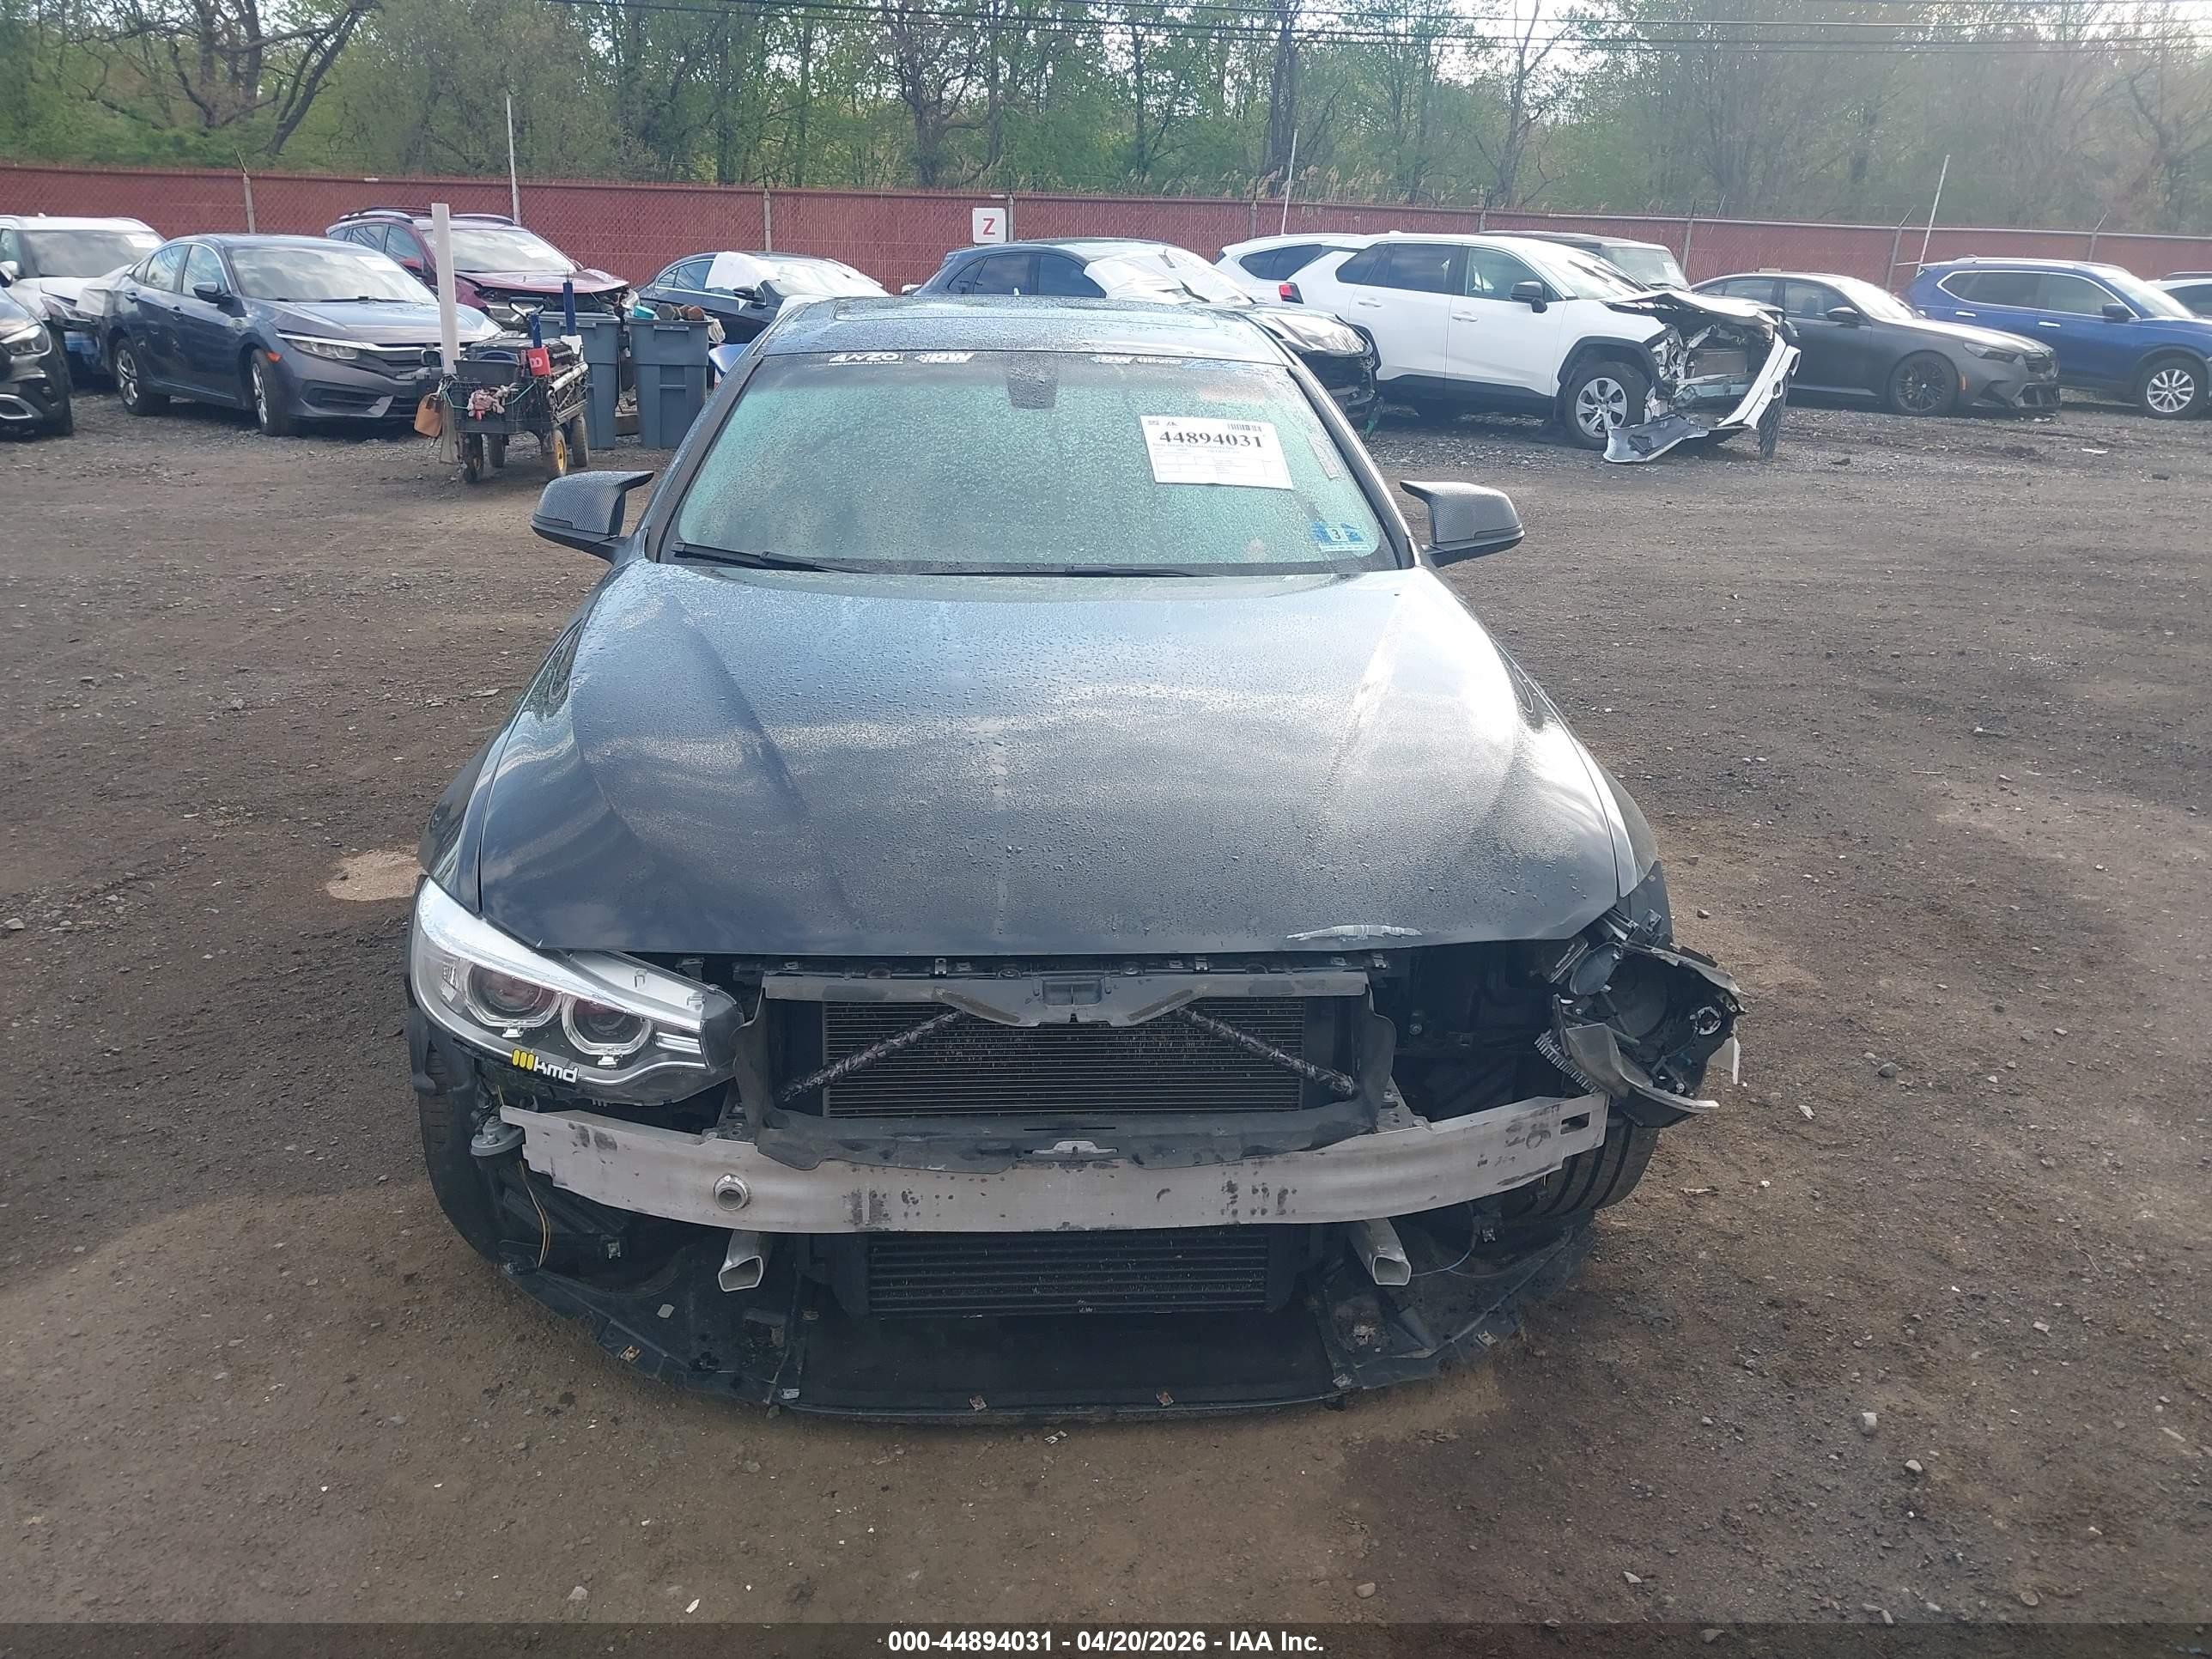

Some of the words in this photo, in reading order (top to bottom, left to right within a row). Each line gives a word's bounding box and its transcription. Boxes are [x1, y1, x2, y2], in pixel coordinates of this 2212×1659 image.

[982, 217, 996, 235] Z
[1159, 431, 1262, 447] 44894031
[1331, 528, 1341, 540] 3
